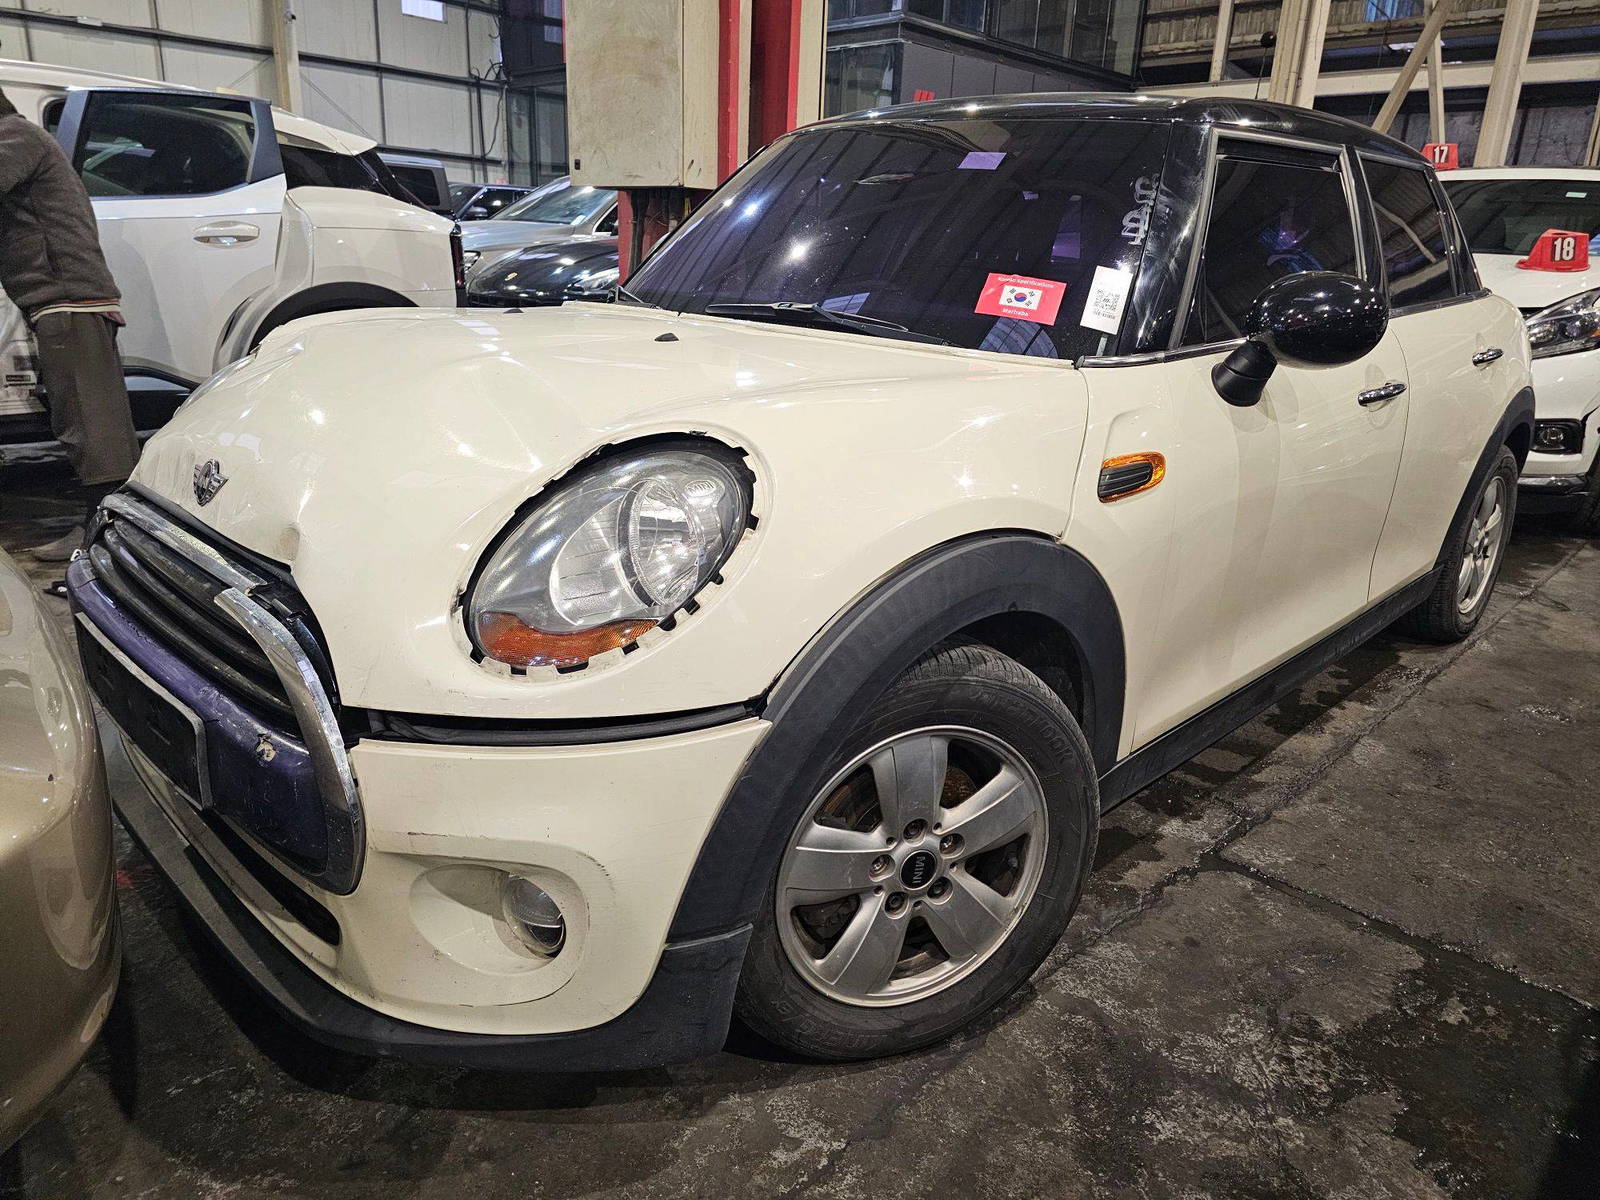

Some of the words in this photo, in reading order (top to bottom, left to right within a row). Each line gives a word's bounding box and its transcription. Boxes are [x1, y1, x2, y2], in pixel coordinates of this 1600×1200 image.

[1433, 145, 1448, 163] 17
[1554, 237, 1575, 261] 18
[912, 856, 926, 884] MINI
